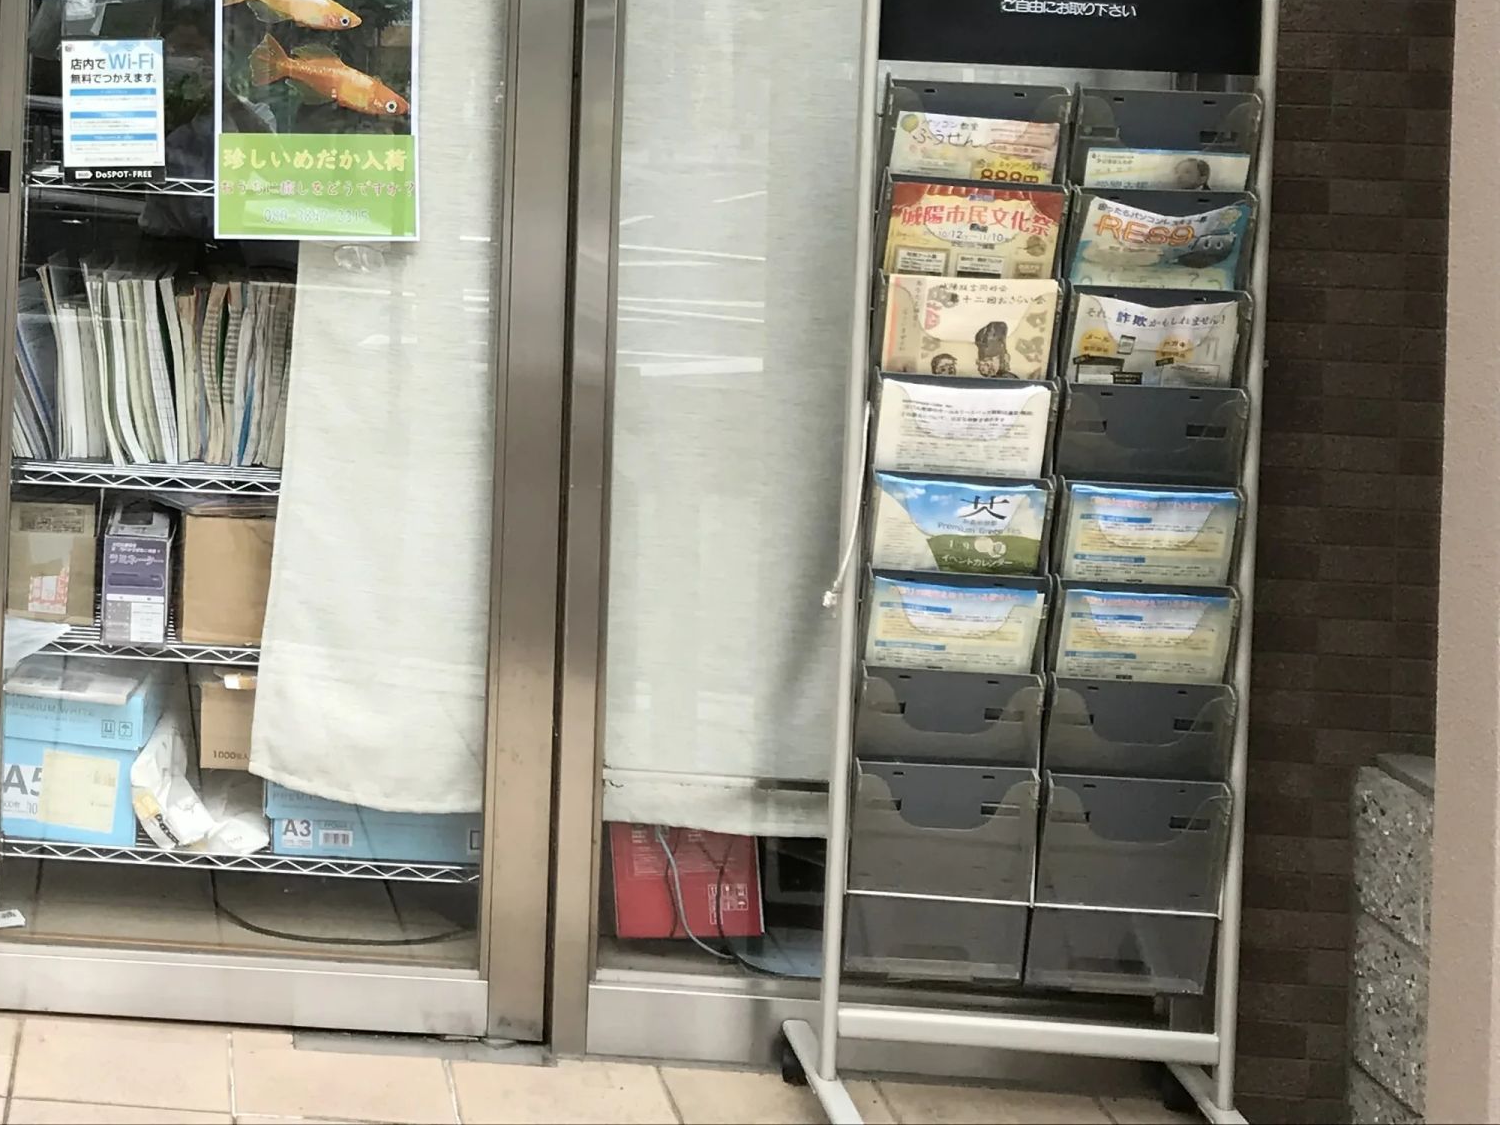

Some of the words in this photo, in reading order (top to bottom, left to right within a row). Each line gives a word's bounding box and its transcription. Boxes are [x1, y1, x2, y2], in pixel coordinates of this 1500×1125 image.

[1001, 0, 1137, 17] ご自由にお取り下さい
[71, 58, 106, 71] 店内で
[108, 53, 155, 70] Wi-Fi
[223, 148, 406, 171] 珍しいめだか入荷
[901, 205, 1054, 237] 城陽市民文化祭
[283, 818, 312, 837] A3
